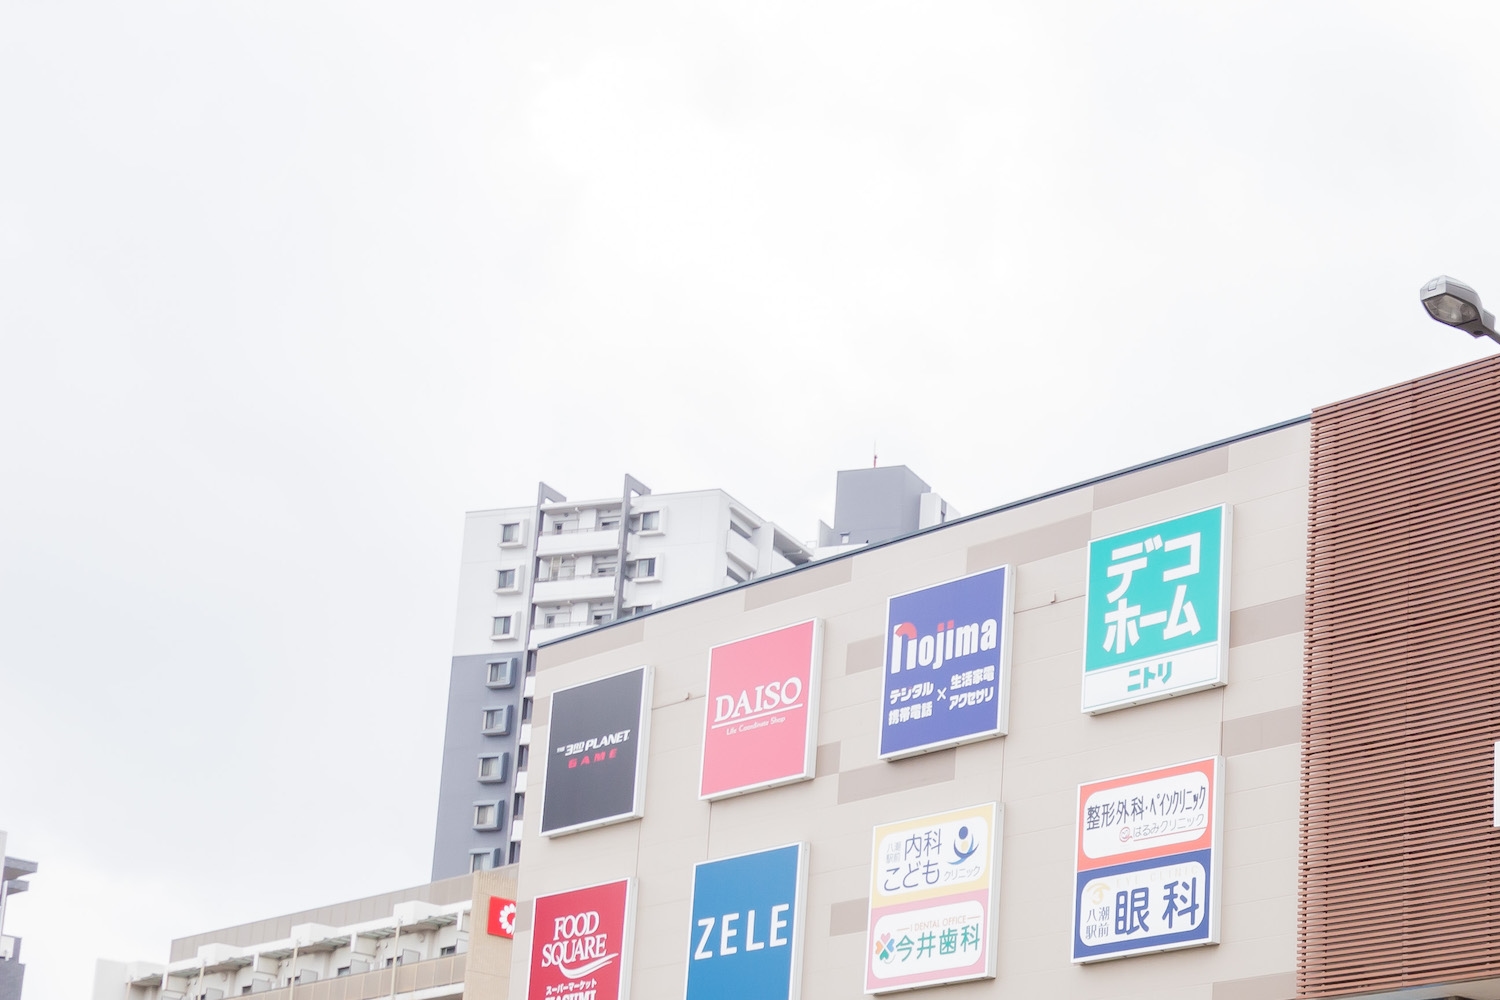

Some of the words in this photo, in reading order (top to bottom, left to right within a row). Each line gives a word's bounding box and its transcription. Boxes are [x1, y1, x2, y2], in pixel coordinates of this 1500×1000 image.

[1106, 532, 1201, 604] デコ
[1102, 584, 1201, 655] ホーム
[950, 665, 995, 690] 生活家電
[1127, 661, 1173, 693] ニトリ
[714, 676, 802, 722] DAISO
[889, 681, 934, 704] デジタル
[948, 686, 994, 711] アクセサリ
[726, 728, 737, 736] Life
[770, 716, 786, 725] Shop
[888, 701, 933, 726] 携帯電話
[564, 741, 585, 756] 3RD
[584, 729, 631, 751] PLANET
[567, 747, 618, 769] GAME
[1132, 813, 1205, 838] はるみクリニック
[904, 828, 942, 861] 内科
[883, 859, 941, 892] こども
[943, 865, 981, 882] クリニック
[1086, 905, 1110, 923] 八潮
[1114, 877, 1199, 936] 眼科
[552, 910, 600, 941] FOOD
[694, 903, 790, 960] ZELE
[914, 918, 941, 932] DENTAL
[942, 915, 967, 928] OFFICE
[1085, 922, 1110, 940] 駅前
[541, 933, 607, 968] SQUARE
[895, 923, 980, 962] 今井歯科
[545, 978, 597, 996] スーパーマーケット
